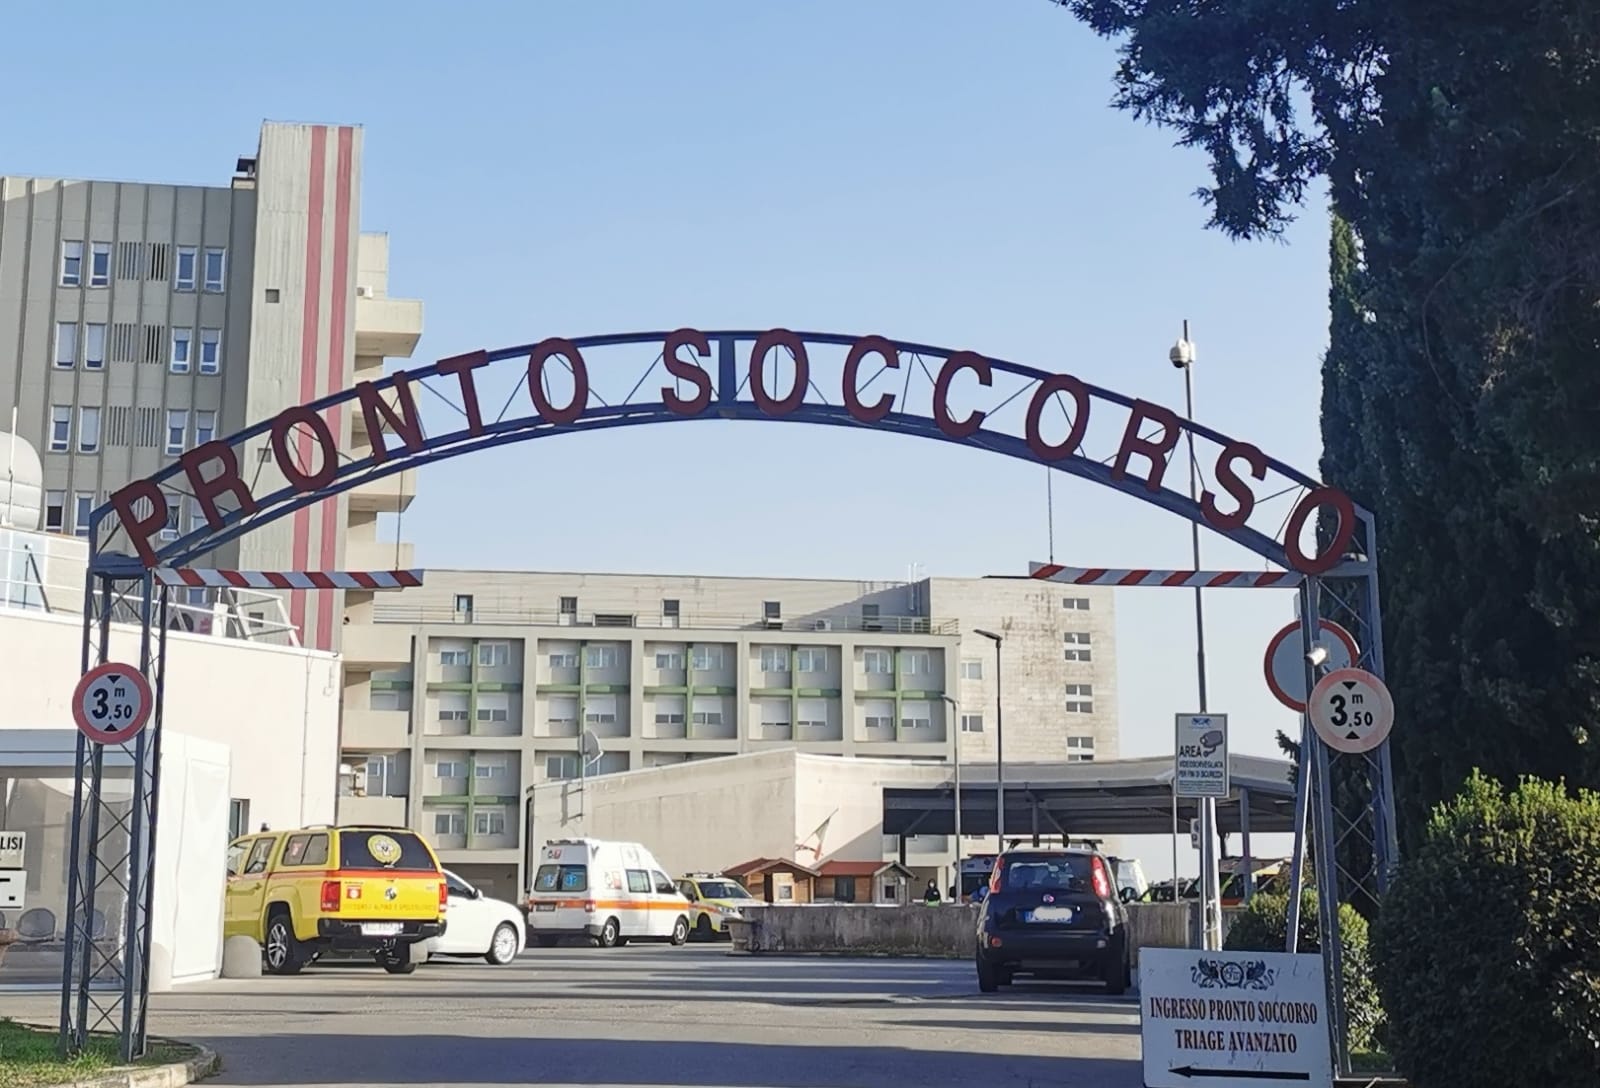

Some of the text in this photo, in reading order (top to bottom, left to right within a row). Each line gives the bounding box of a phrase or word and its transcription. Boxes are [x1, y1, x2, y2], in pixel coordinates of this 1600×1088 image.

[110, 327, 1355, 575] PRONTO SOCCORSO
[114, 687, 125, 698] m
[1351, 694, 1363, 704] m
[1179, 745, 1201, 757] AREA
[0, 836, 23, 850] LISI
[1150, 997, 1318, 1025] INGRESSO PRONTO SOCCORSO
[1174, 1029, 1298, 1054] TRIAGE AVANZATO
